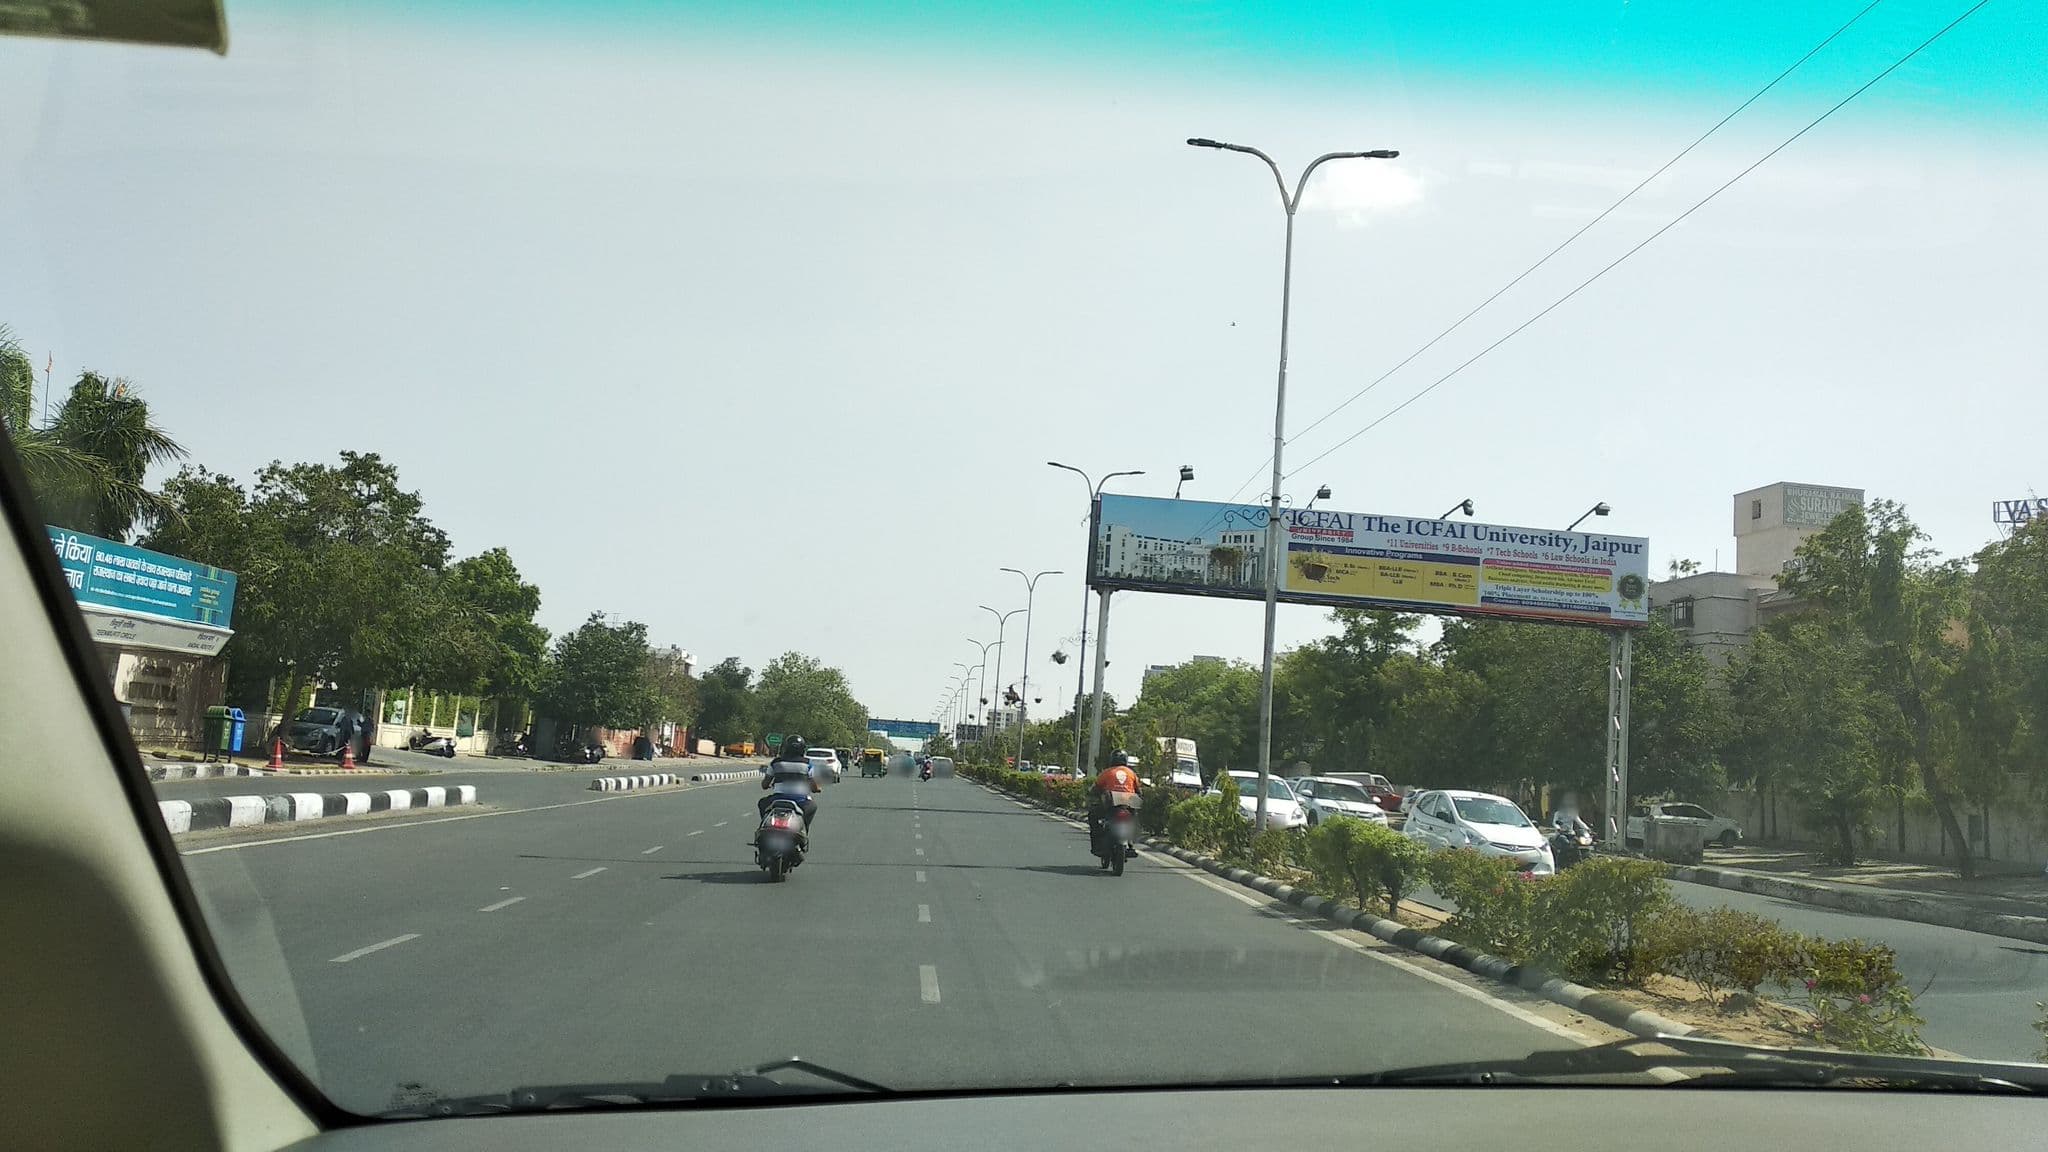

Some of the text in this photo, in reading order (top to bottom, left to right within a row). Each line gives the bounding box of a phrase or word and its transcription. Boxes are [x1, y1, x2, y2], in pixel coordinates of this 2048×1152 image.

[1290, 509, 1354, 529] ICFAI
[1291, 533, 1314, 542] Group
[1363, 516, 1643, 557] The ICFAI University, Jaipur
[66, 535, 93, 564] किया
[1345, 547, 1423, 560] Innovative Programs
[1400, 540, 1438, 551] Universities
[1496, 548, 1511, 557] Tech
[1513, 549, 1538, 559] Schools
[1565, 554, 1591, 564] Schools
[1592, 556, 1599, 564] in
[1600, 557, 1617, 566] India
[1531, 588, 1565, 597] Scholarship
